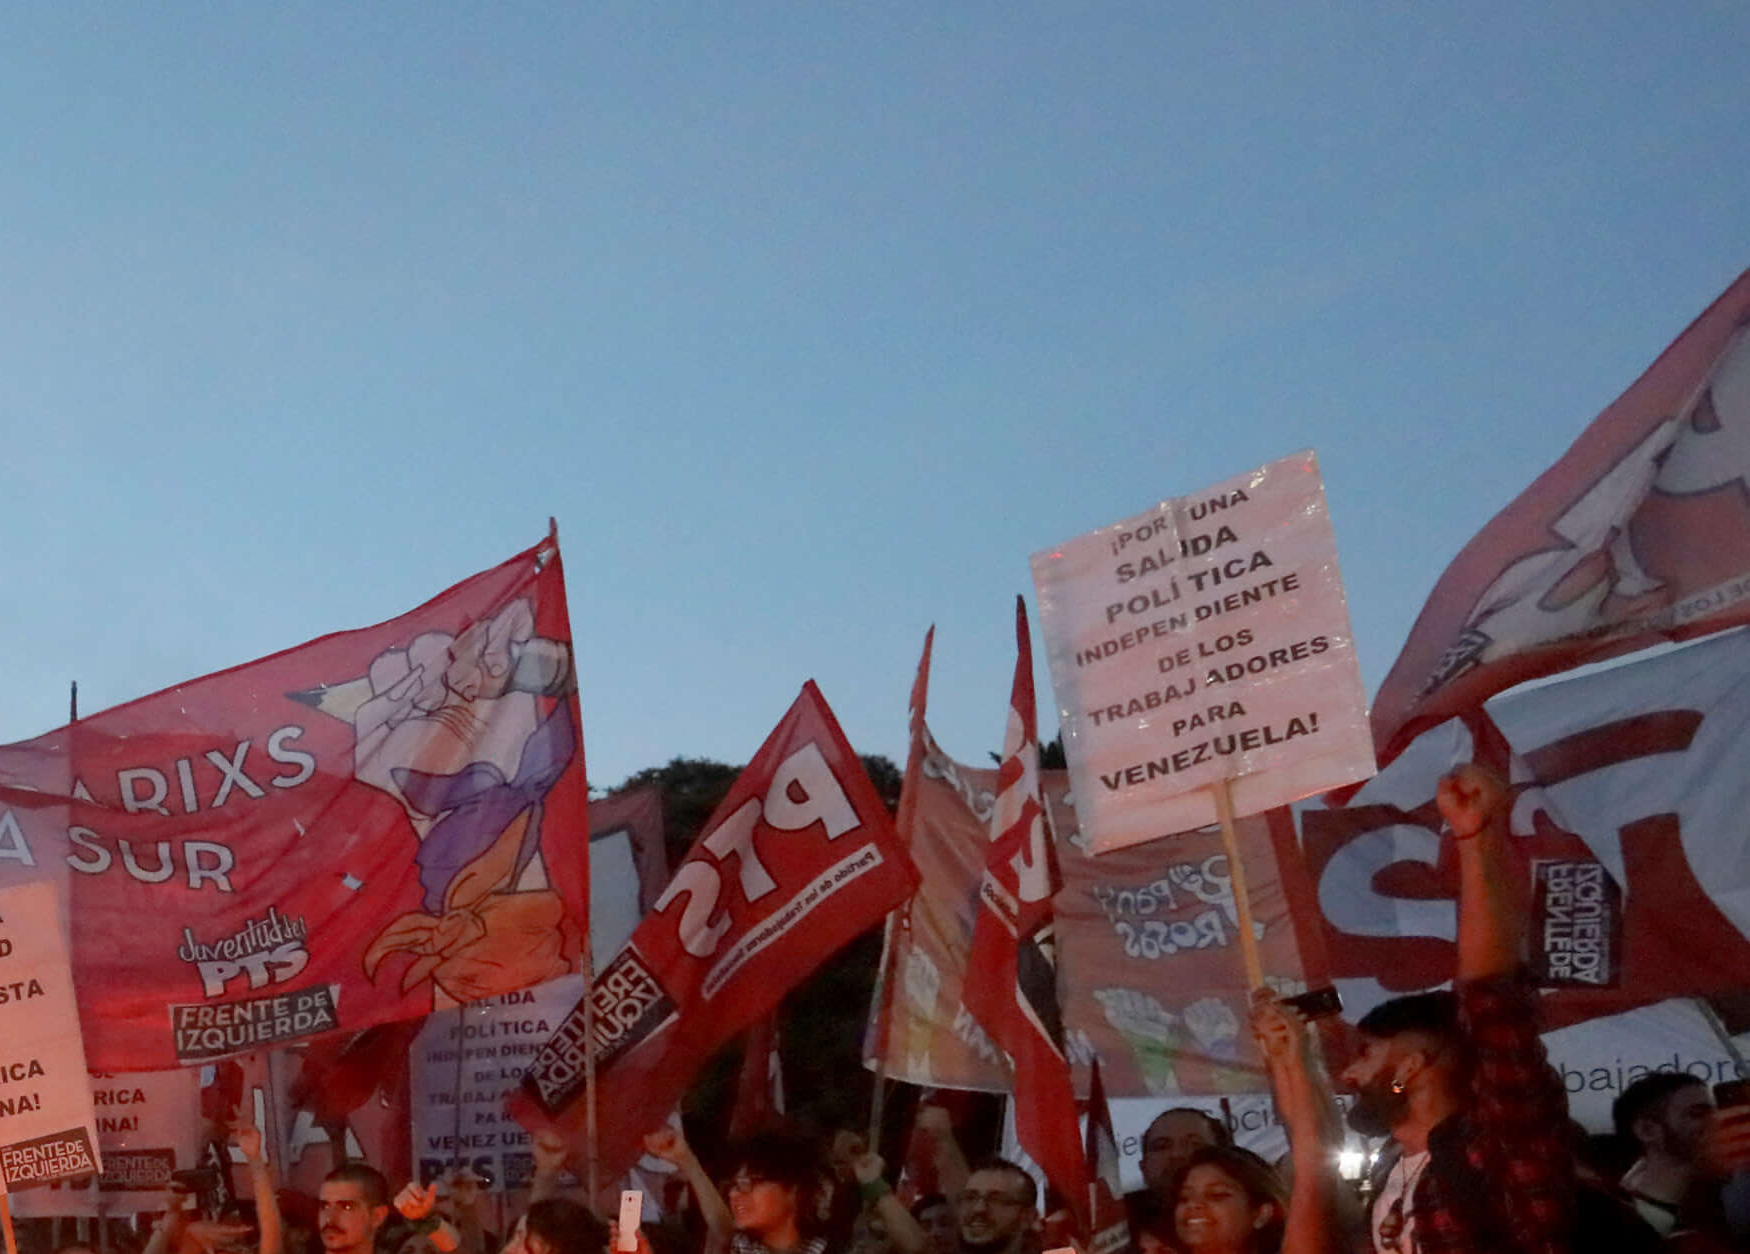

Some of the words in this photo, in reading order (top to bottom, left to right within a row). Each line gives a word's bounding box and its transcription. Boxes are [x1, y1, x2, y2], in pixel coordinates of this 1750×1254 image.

[1189, 489, 1250, 521] UNA
[1115, 525, 1238, 584] SALIDA
[1158, 650, 1192, 674] DE
[1199, 628, 1254, 658] LOS
[1172, 701, 1246, 736] PARA
[1100, 712, 1319, 792] VENEZUELA!
[66, 826, 235, 893] SUR
[196, 940, 311, 998] PTS
[180, 998, 289, 1028] FRENTE
[297, 991, 328, 1011] DE
[177, 1010, 332, 1051] IZQUIERDA
[94, 1088, 145, 1106] RICA
[2, 1140, 65, 1168] FRENTE
[66, 1140, 84, 1154] DE
[5, 1152, 93, 1183] IZQUIERDA
